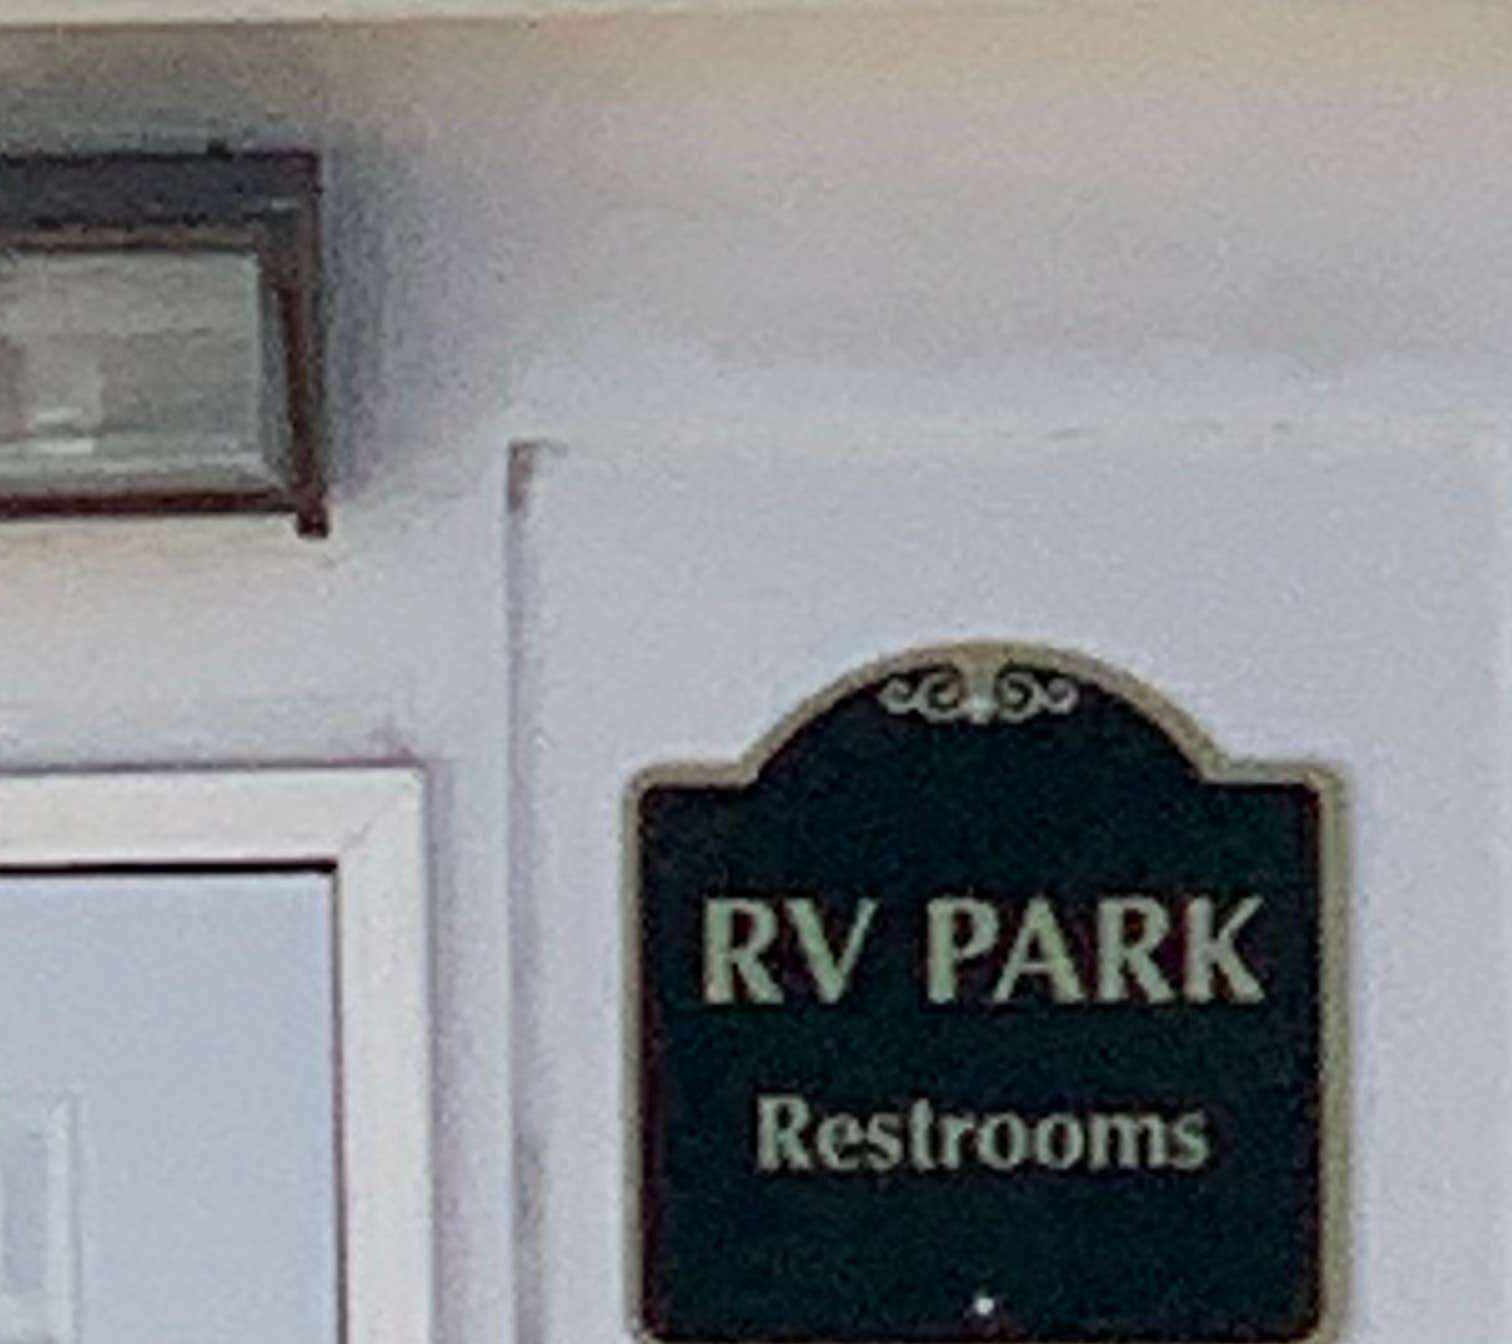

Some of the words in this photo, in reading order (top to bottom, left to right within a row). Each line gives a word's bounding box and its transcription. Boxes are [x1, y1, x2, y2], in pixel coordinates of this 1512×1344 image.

[702, 897, 879, 1003] RV
[925, 895, 1266, 1003] PARK
[755, 1095, 1212, 1171] Restrooms
